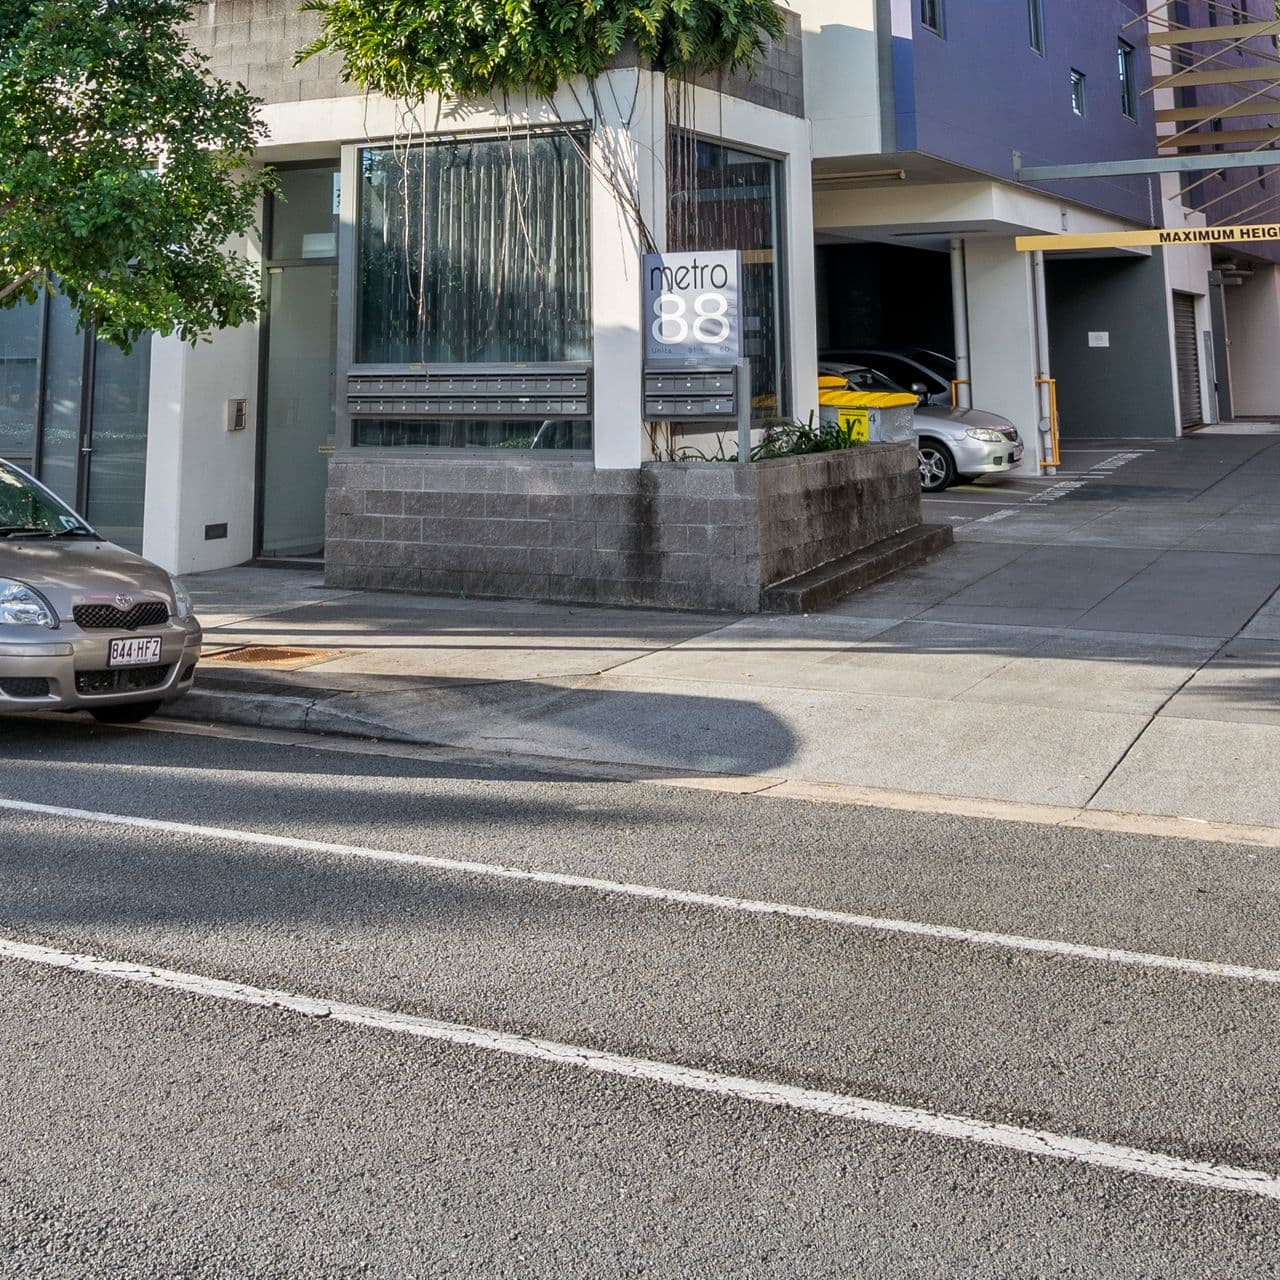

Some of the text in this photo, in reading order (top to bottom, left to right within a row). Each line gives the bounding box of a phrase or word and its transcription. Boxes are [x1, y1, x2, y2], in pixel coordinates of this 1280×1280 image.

[1160, 229, 1235, 243] MAXIMUM
[650, 258, 728, 291] metro
[651, 292, 730, 344] 88
